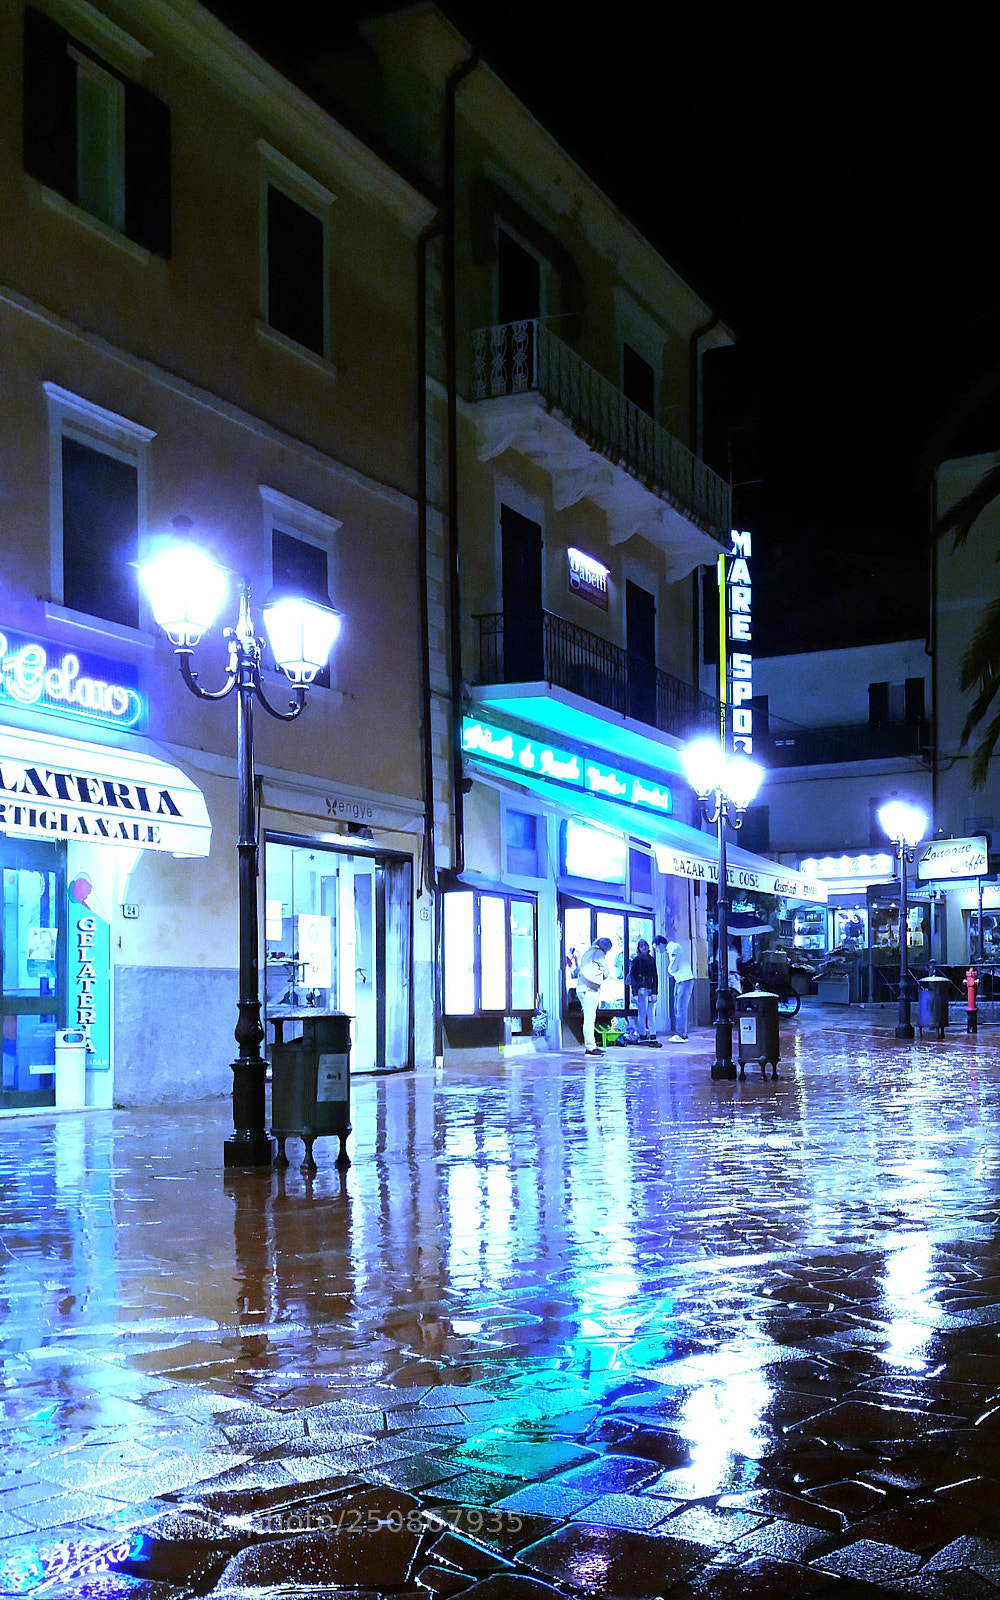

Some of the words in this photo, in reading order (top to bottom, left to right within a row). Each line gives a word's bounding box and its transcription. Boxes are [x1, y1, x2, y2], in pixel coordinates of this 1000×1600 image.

[730, 529, 752, 641] MARE
[2, 644, 140, 724] Gelato
[0, 762, 183, 817] LATERIA
[127, 905, 136, 915] 24
